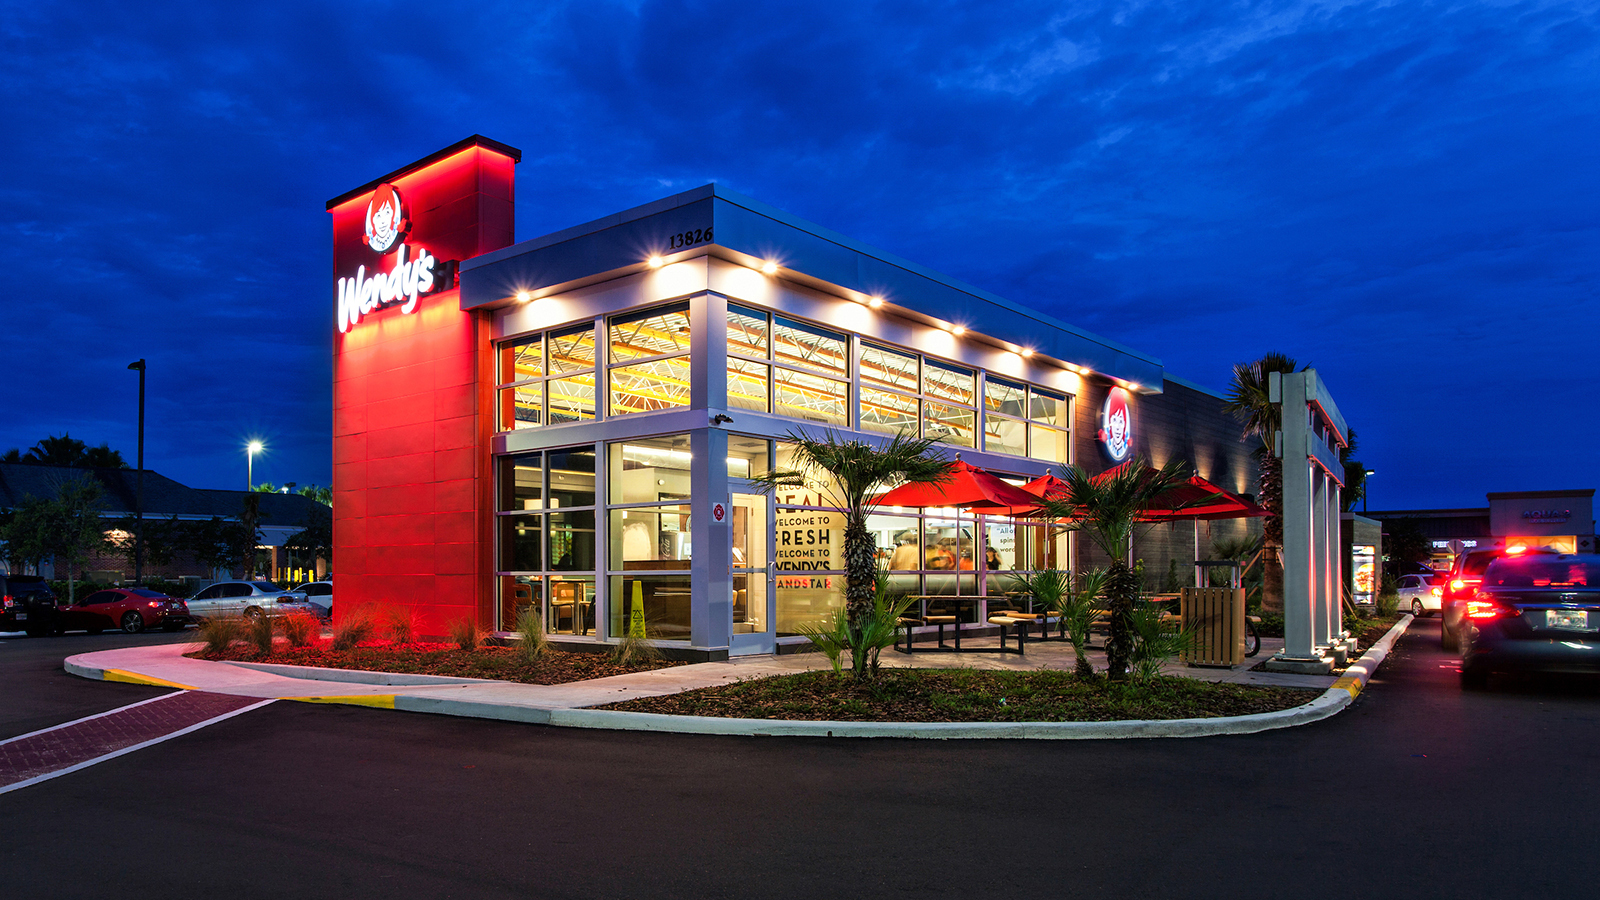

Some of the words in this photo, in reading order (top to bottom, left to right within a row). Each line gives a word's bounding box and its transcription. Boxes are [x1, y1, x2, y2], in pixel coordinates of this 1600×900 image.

[669, 226, 714, 250] 13826
[338, 243, 435, 334] Wendy's
[818, 479, 830, 489] TO
[818, 516, 830, 524] TO
[775, 528, 830, 546] RESH
[818, 548, 830, 557] TO
